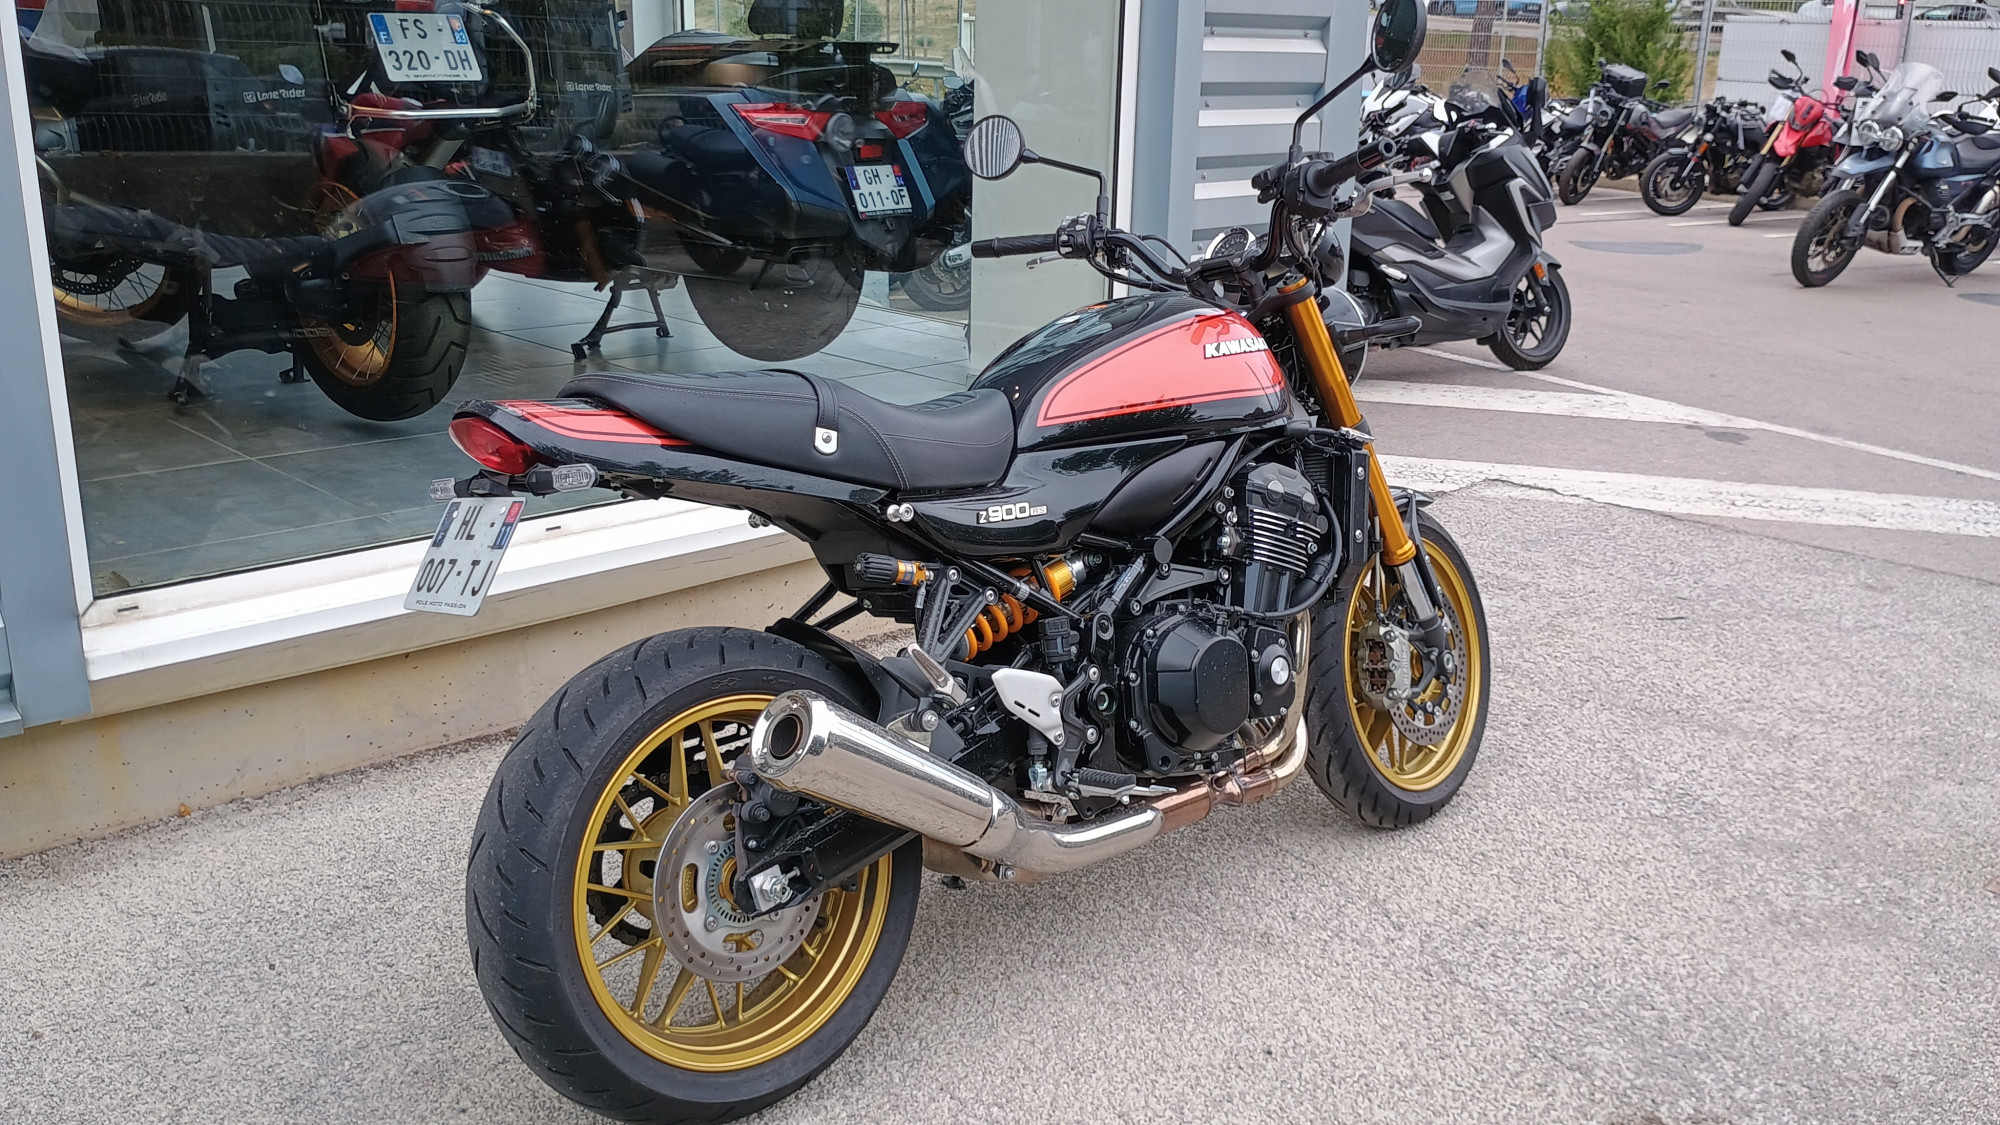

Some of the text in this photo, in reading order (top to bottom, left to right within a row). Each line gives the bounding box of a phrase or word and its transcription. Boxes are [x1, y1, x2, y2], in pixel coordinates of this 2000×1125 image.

[379, 31, 388, 42] F
[398, 18, 428, 39] FS
[455, 32, 466, 43] 83
[388, 50, 473, 71] 320-DH
[256, 91, 279, 102] Lone
[279, 88, 306, 99] Rider
[863, 168, 882, 185] GH
[454, 506, 483, 540] HL
[495, 525, 512, 546] 11
[416, 558, 494, 597] 007-TJ
